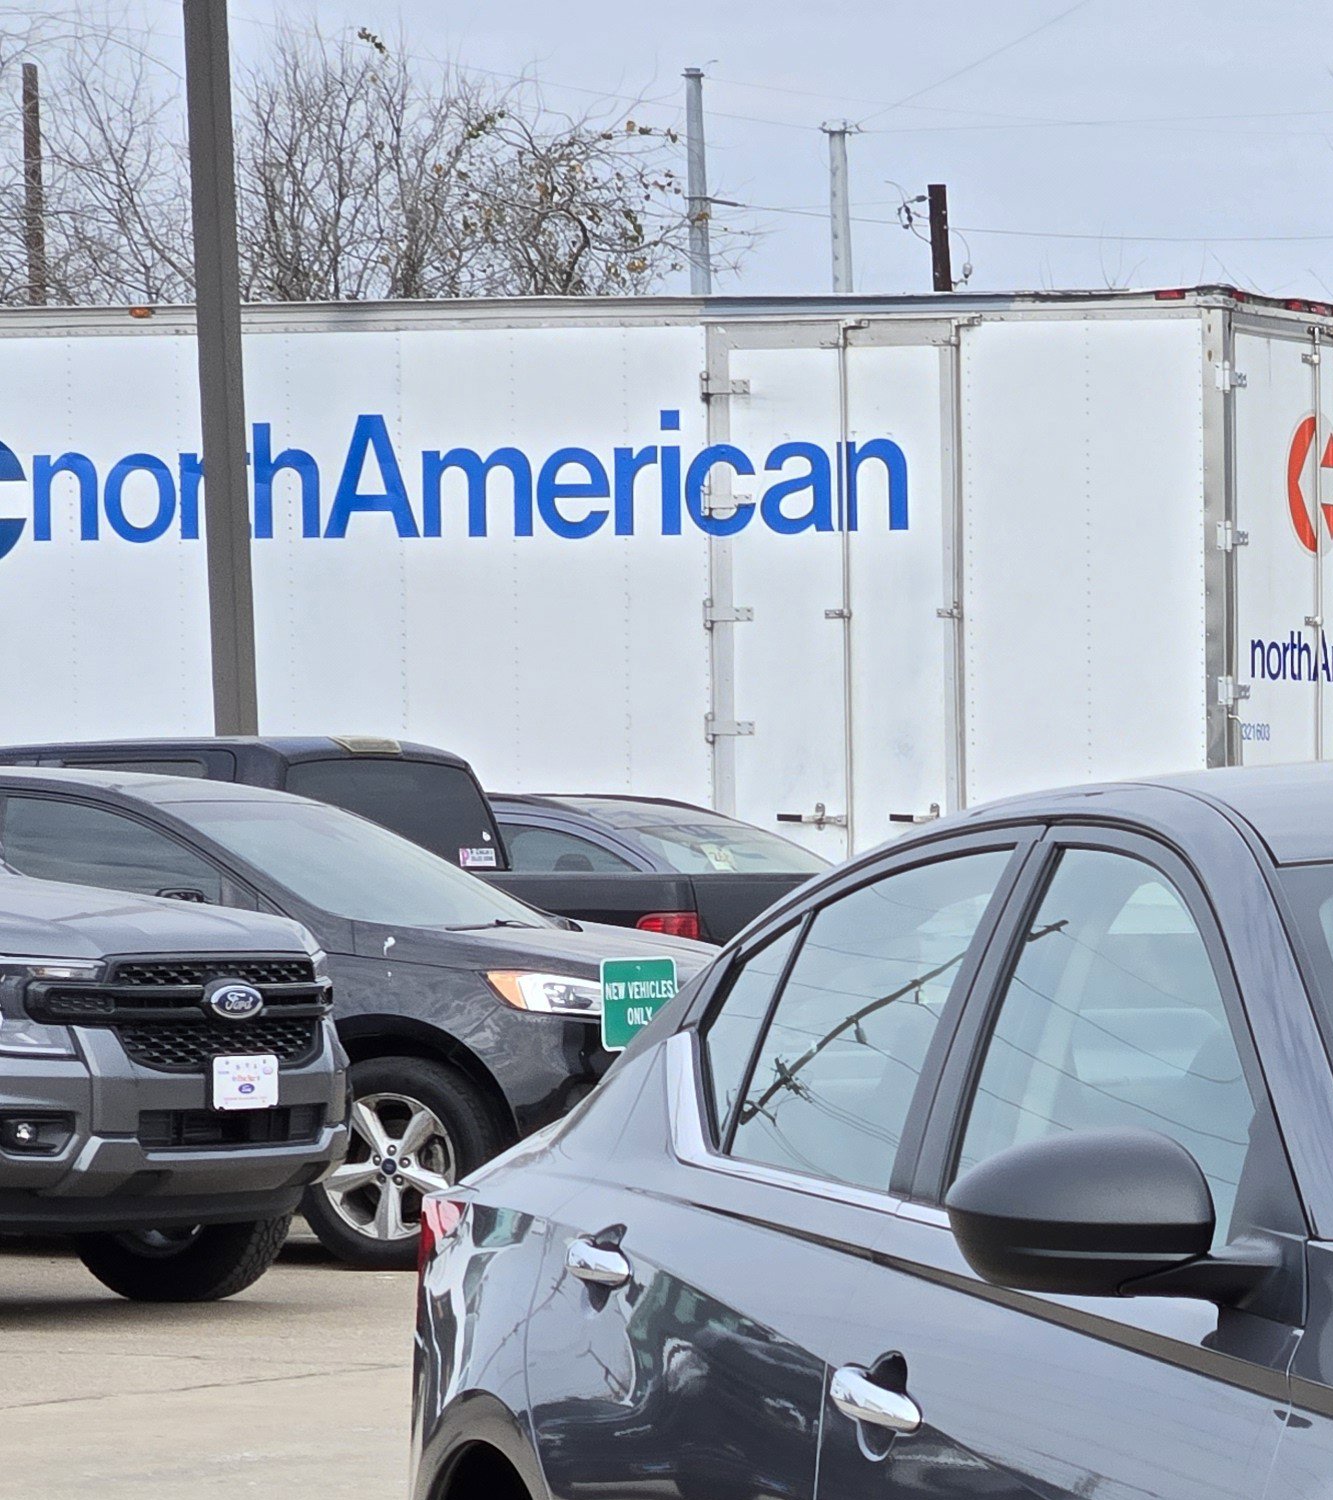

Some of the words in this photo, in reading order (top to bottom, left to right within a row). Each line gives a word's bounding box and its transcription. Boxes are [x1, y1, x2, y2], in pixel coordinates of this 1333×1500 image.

[32, 409, 909, 543] norhAmerican
[605, 982, 625, 1000] NEW
[627, 980, 675, 999] VEHICLES
[225, 991, 253, 1010] Ford
[627, 1006, 653, 1025] ONLY
